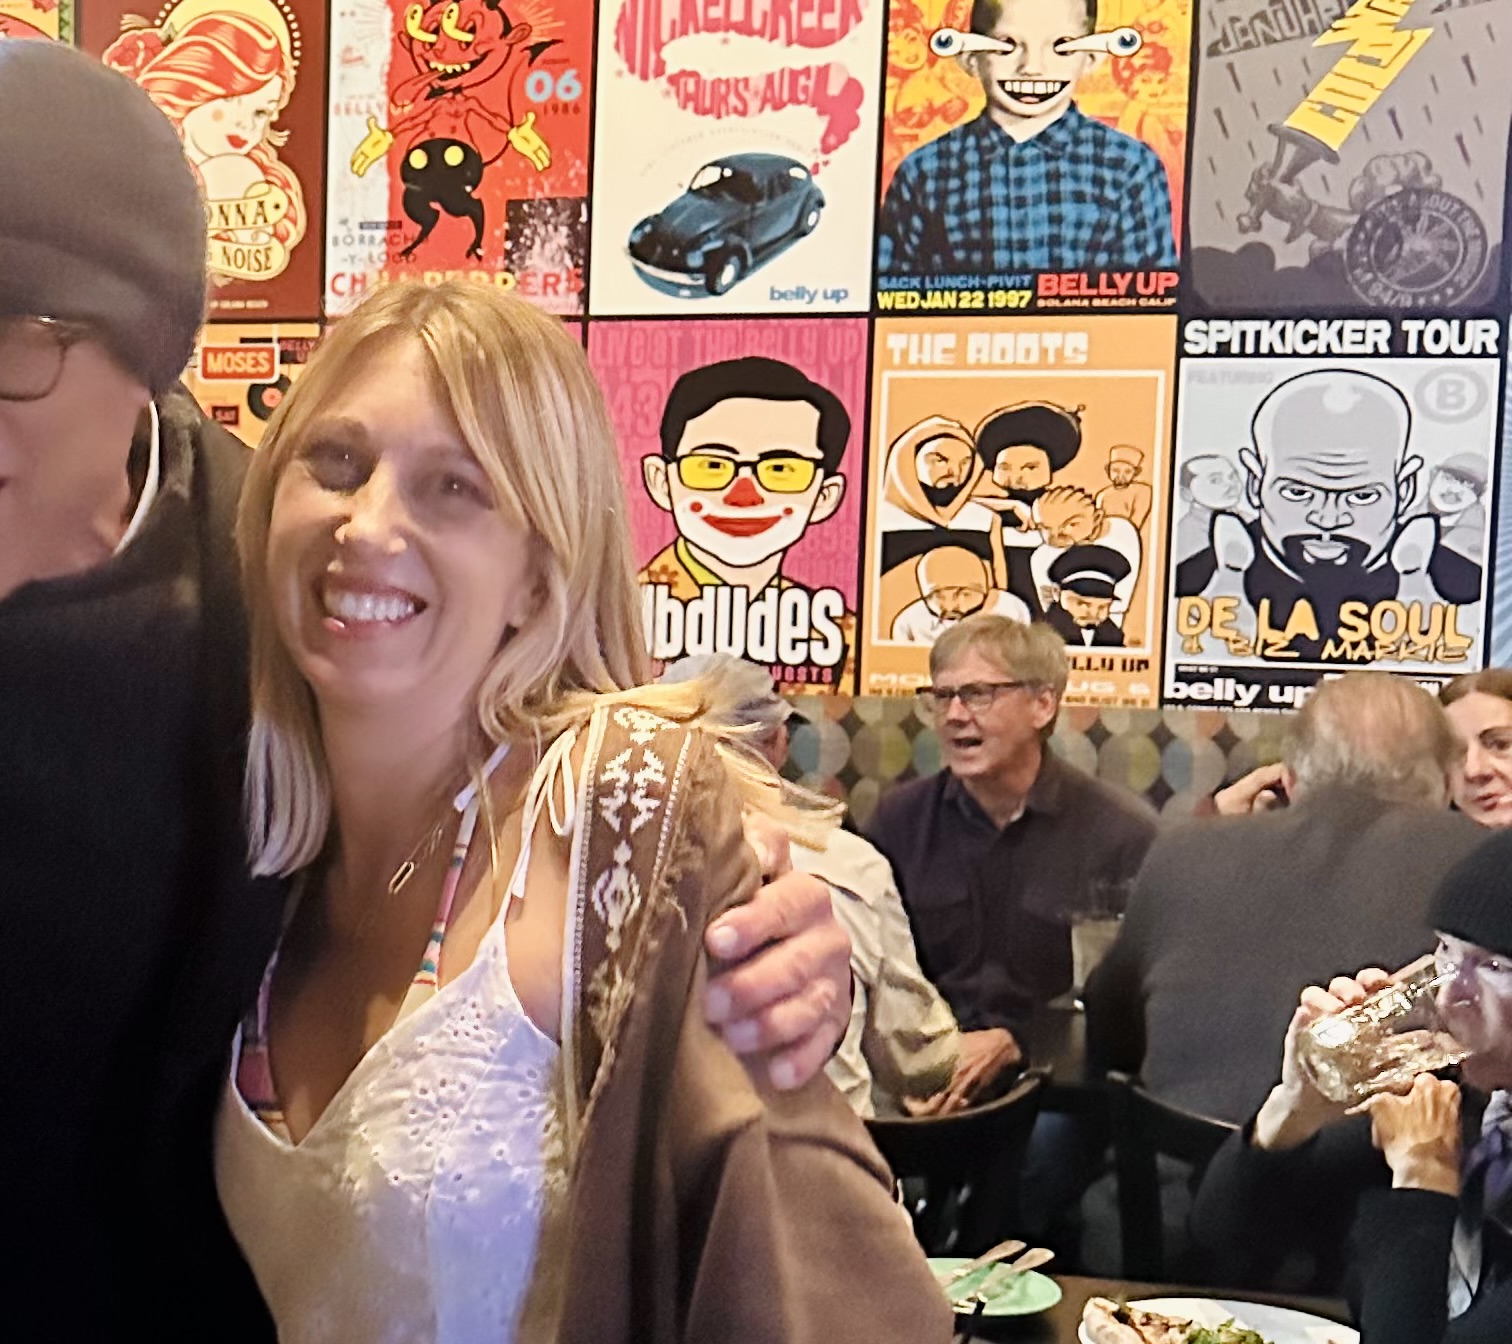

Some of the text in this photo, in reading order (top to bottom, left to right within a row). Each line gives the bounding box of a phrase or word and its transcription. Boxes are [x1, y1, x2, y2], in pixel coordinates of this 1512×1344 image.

[524, 68, 583, 103] 06
[542, 102, 583, 117] 1986
[221, 245, 273, 273] NOISE
[769, 283, 850, 306] belly up
[1037, 271, 1180, 297] BELLY UP
[876, 289, 1033, 310] WED JAN 22 1997
[1037, 297, 1137, 308] SOLANA BEACH
[888, 331, 1089, 364] THE ROOTS
[1183, 318, 1500, 355] SPITKICKER TOUR
[206, 351, 271, 375] MOSES
[1177, 596, 1474, 650] DE LA SOUL
[1226, 634, 1300, 658] BIZ
[1163, 677, 1263, 708] belly
